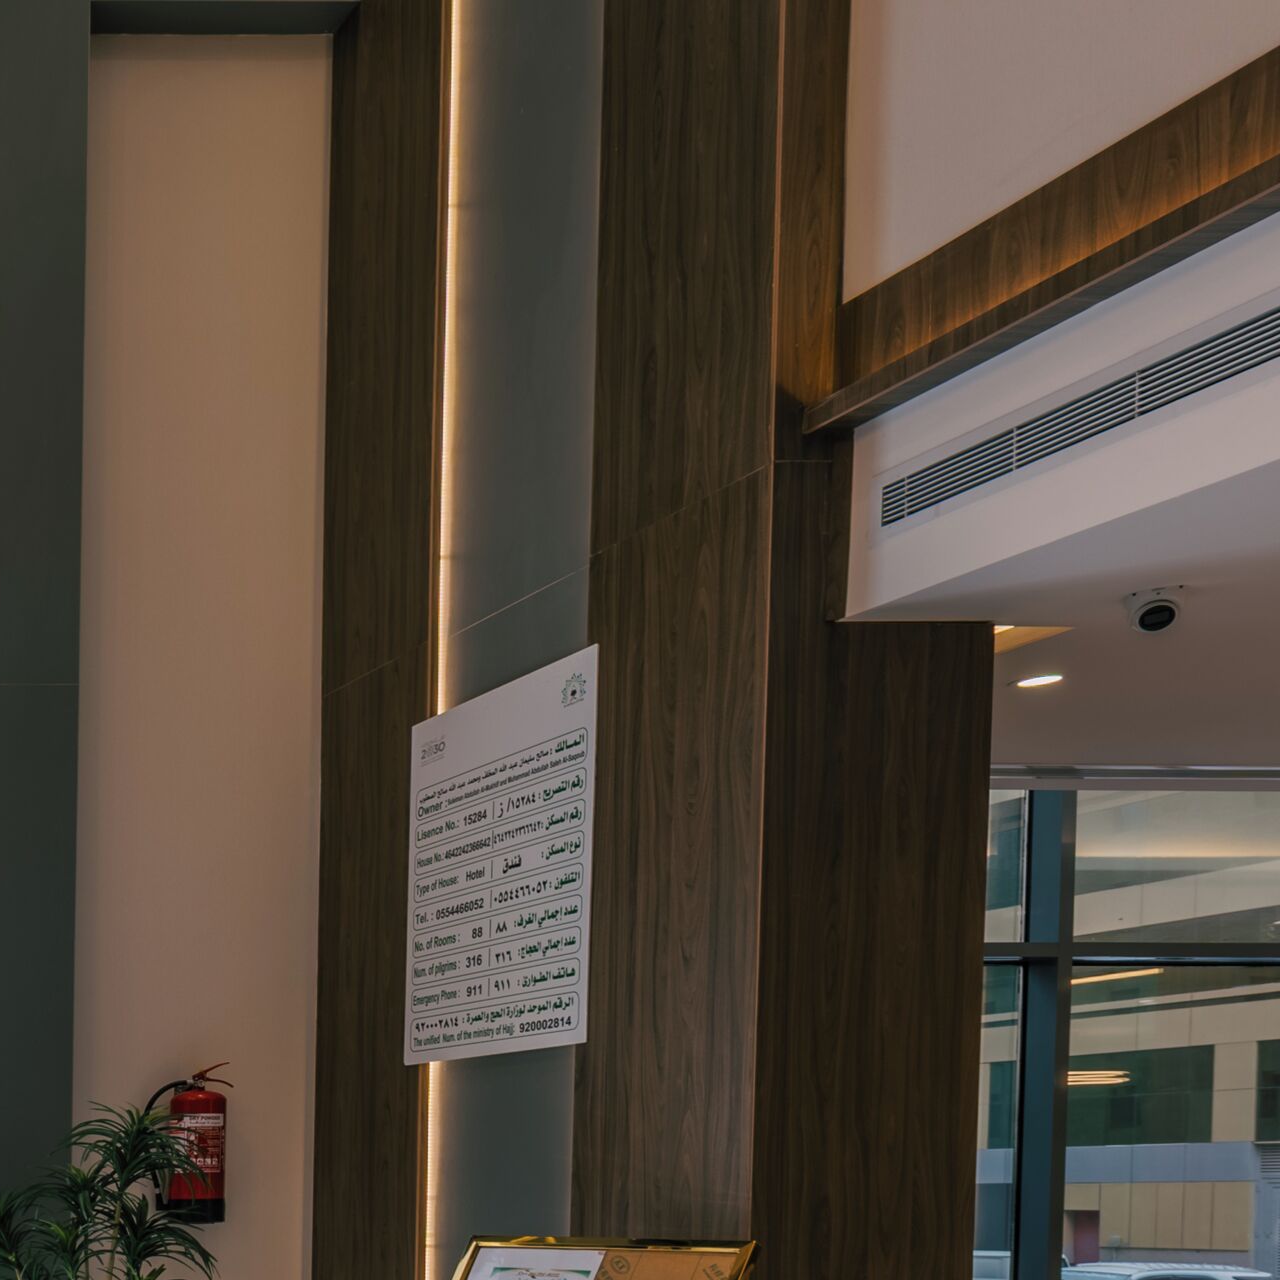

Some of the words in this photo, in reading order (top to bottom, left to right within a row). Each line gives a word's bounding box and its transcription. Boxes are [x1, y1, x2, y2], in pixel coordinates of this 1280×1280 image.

[554, 734, 584, 753] المالك
[570, 774, 583, 790] رقم
[542, 780, 569, 801] التصريح
[417, 801, 442, 817] Owner
[569, 806, 581, 822] رقم
[416, 825, 443, 841] Lisence
[463, 809, 486, 825] 15284
[545, 811, 568, 829] المسكن
[545, 842, 568, 859] المسكن
[569, 836, 581, 854] نوع
[416, 856, 432, 868] House
[502, 854, 521, 873] فندق
[416, 884, 429, 897] Type
[430, 879, 437, 891] of
[465, 866, 484, 881] Hotel
[554, 871, 580, 889] التلفون
[415, 911, 428, 924] Tel.
[435, 898, 483, 919] 0554466052
[563, 904, 578, 915] عدد
[495, 921, 507, 933] ٨٨
[414, 941, 424, 952] No.
[425, 937, 432, 949] of
[433, 934, 456, 947] Rooms
[471, 926, 482, 938] 88
[563, 936, 576, 946] عدد
[495, 950, 511, 962] ٣١٦
[428, 963, 434, 975] of
[465, 954, 482, 968] 316
[552, 967, 575, 979] هاتف
[494, 978, 510, 991] ٩١١
[412, 994, 439, 1006] Emergency
[466, 984, 482, 997] 911
[506, 1004, 525, 1018] لوزارة
[527, 1000, 551, 1014] الموحد
[552, 996, 573, 1011] الرقم
[466, 1011, 488, 1024] والعمرة
[490, 1008, 505, 1022] الحج
[413, 1037, 422, 1046] The
[456, 1030, 462, 1040] of
[463, 1030, 471, 1039] the
[495, 1025, 501, 1035] of
[519, 1016, 571, 1032] 920002814
[415, 1016, 458, 1032] ٩٢٠٠٠٢٨١٤
